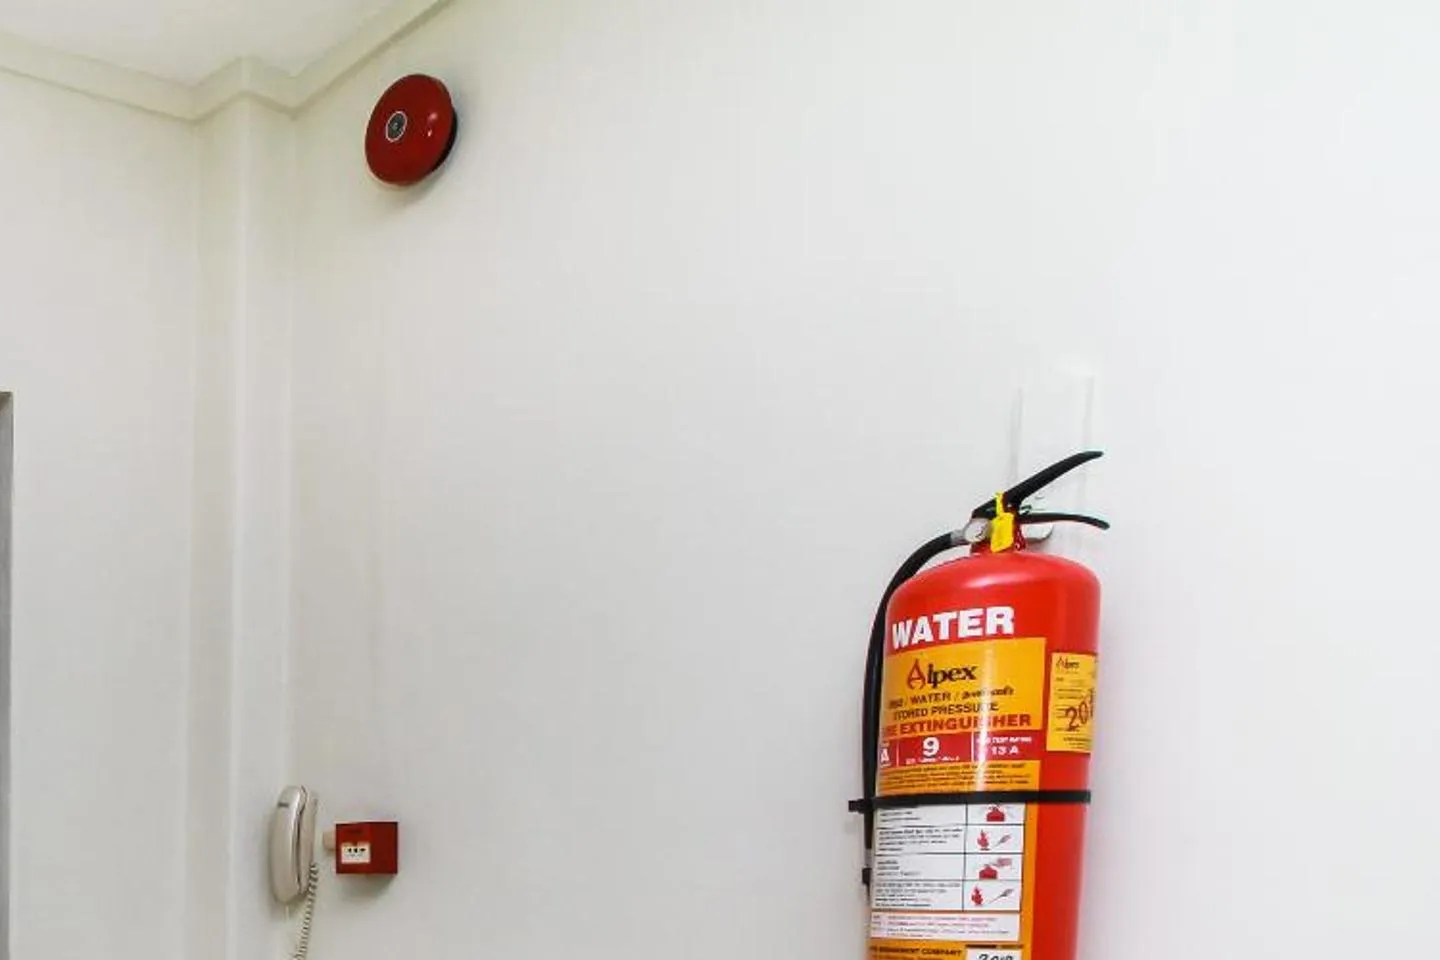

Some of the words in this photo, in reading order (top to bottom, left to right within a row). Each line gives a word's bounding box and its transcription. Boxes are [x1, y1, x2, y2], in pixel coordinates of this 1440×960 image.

[892, 606, 1015, 650] WATER
[907, 659, 977, 690] Alpex
[931, 702, 1000, 716] PRESSUE
[901, 713, 1032, 735] EXTINGUIHER
[922, 736, 940, 758] 9
